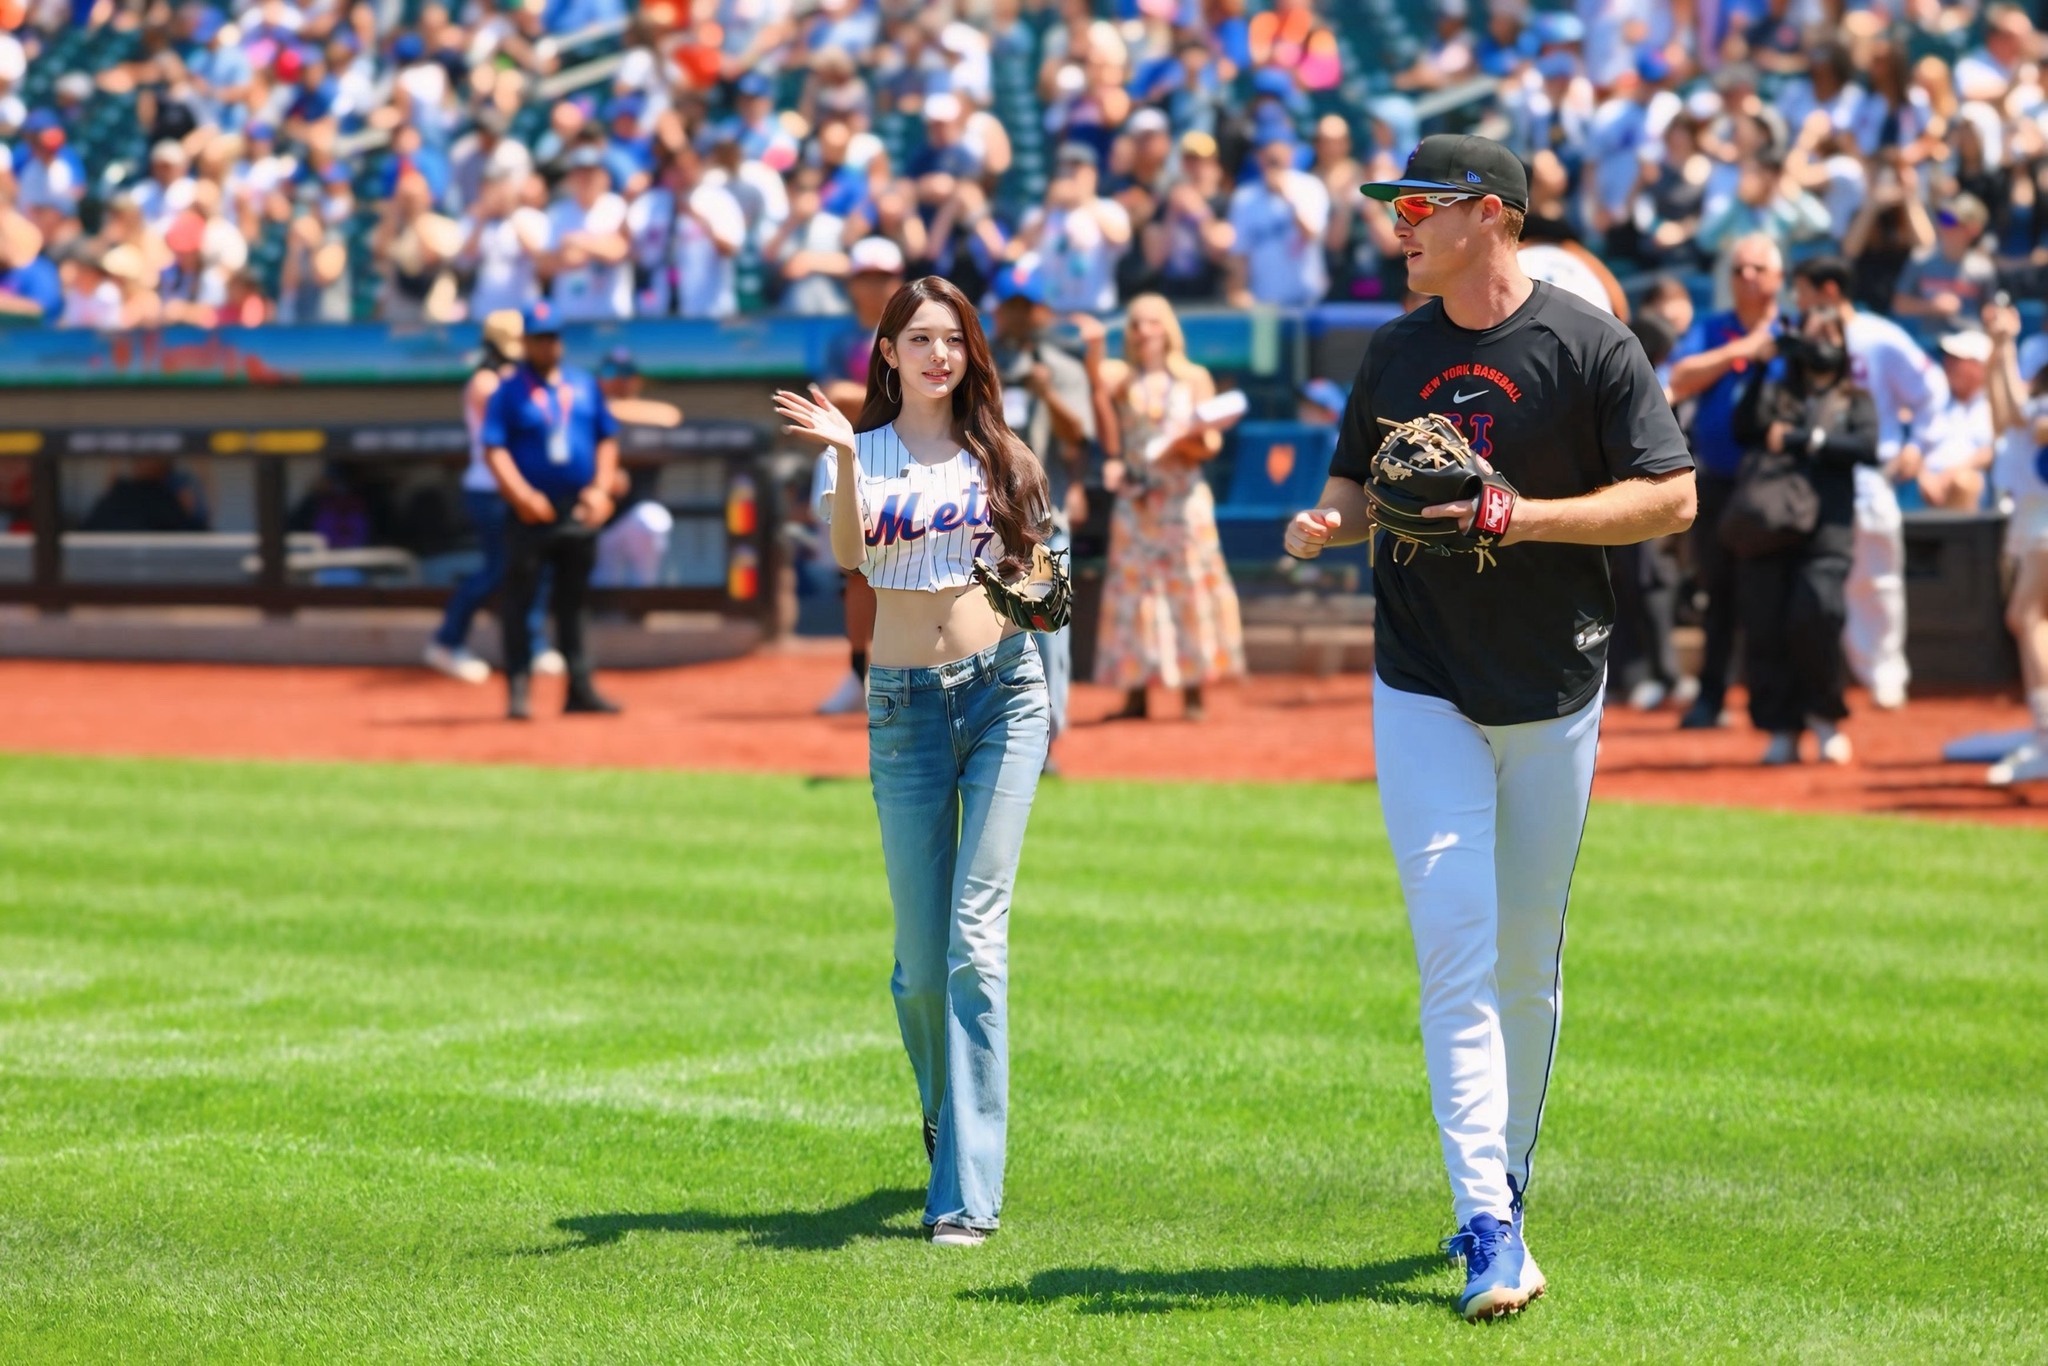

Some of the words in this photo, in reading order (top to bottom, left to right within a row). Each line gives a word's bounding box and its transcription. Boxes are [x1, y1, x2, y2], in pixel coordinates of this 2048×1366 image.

[1419, 376, 1441, 400] NEW
[1442, 363, 1470, 381] YORK
[1473, 364, 1522, 403] BASEBALL
[865, 481, 993, 547] Met
[971, 532, 996, 558] 7
